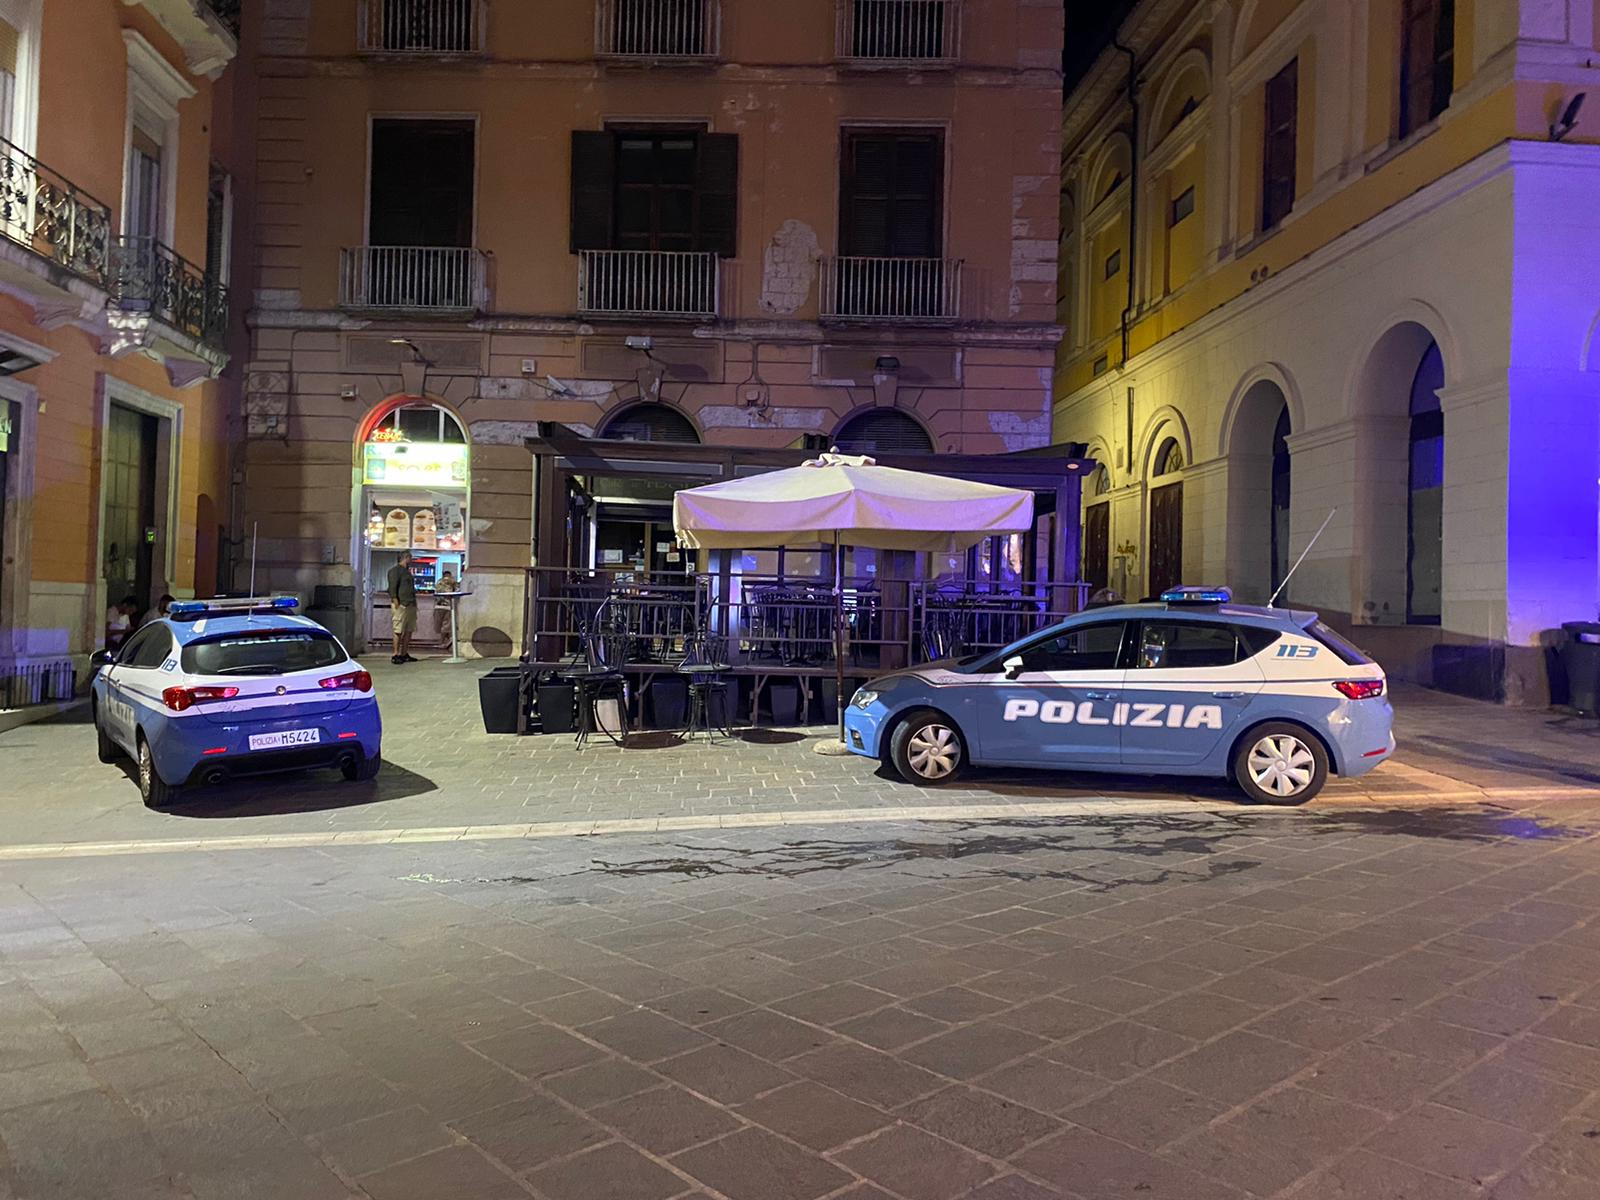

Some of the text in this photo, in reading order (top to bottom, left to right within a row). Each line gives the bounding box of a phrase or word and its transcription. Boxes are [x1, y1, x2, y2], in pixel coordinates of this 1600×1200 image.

[1276, 644, 1319, 658] 113
[161, 658, 178, 672] 113
[1003, 699, 1223, 729] POLIZIA
[252, 730, 317, 746] POLIZIA M5424
